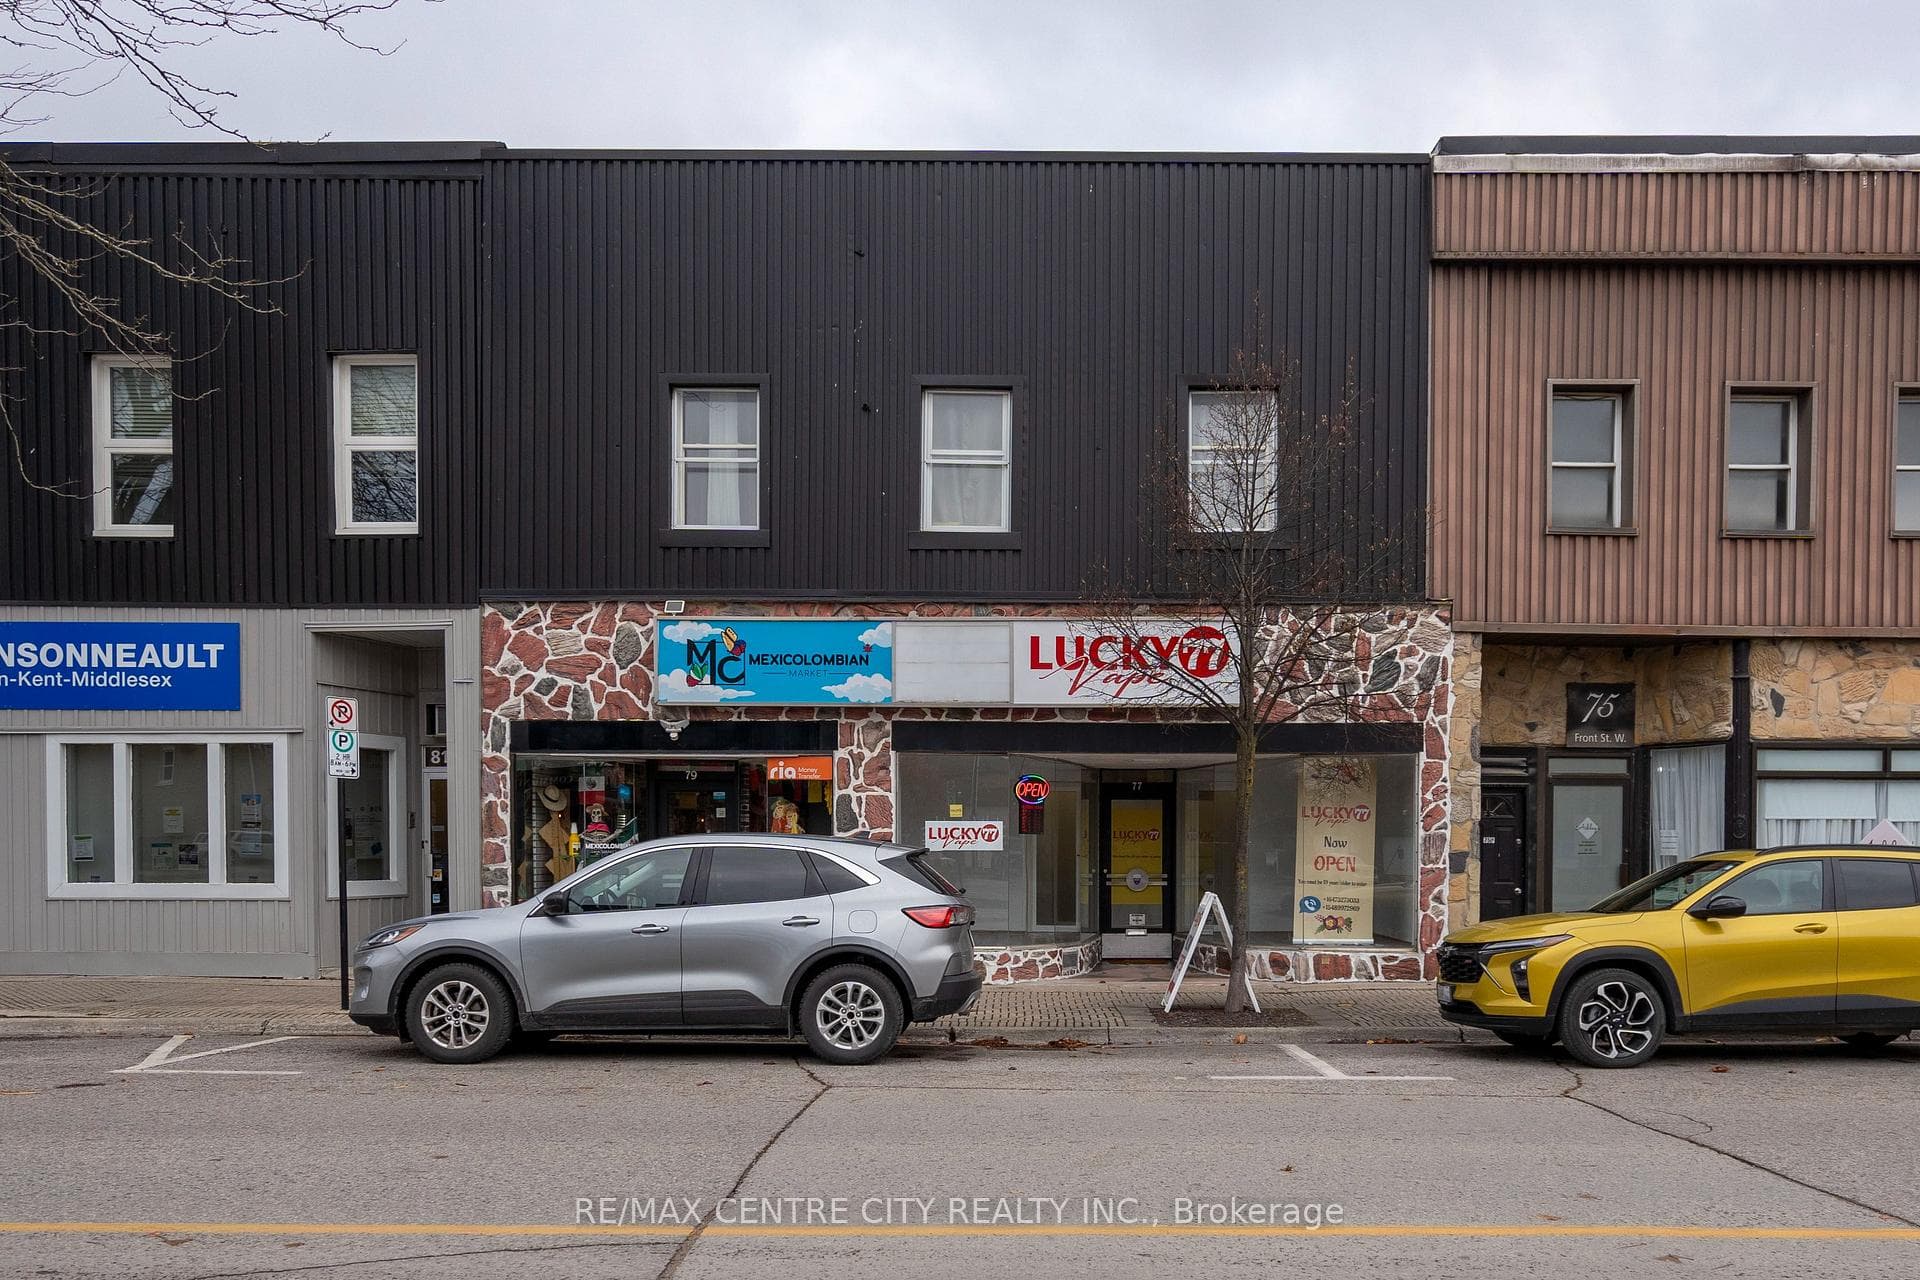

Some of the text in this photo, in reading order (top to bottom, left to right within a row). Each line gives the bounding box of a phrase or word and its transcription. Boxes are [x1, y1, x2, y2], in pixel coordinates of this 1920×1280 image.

[0, 642, 225, 668] NSONNEAULT
[749, 653, 869, 666] MEXICOLOMBIAN
[1030, 635, 1180, 670] LUCKY
[0, 671, 173, 688] n-Kent-Middlesex
[788, 669, 829, 678] MARKET
[1039, 655, 1166, 698] Vape
[1581, 692, 1621, 723] 75
[1574, 732, 1627, 743] Front St. W.
[685, 770, 698, 781] 79
[769, 760, 797, 779] ria
[1017, 782, 1047, 797] OPEN
[1132, 781, 1143, 791] 77
[1301, 806, 1370, 820] LUCKY 77
[928, 827, 998, 841] LUCKY 77
[935, 834, 977, 849] Vape
[1324, 835, 1348, 848] Now
[1313, 855, 1356, 873] OPEN
